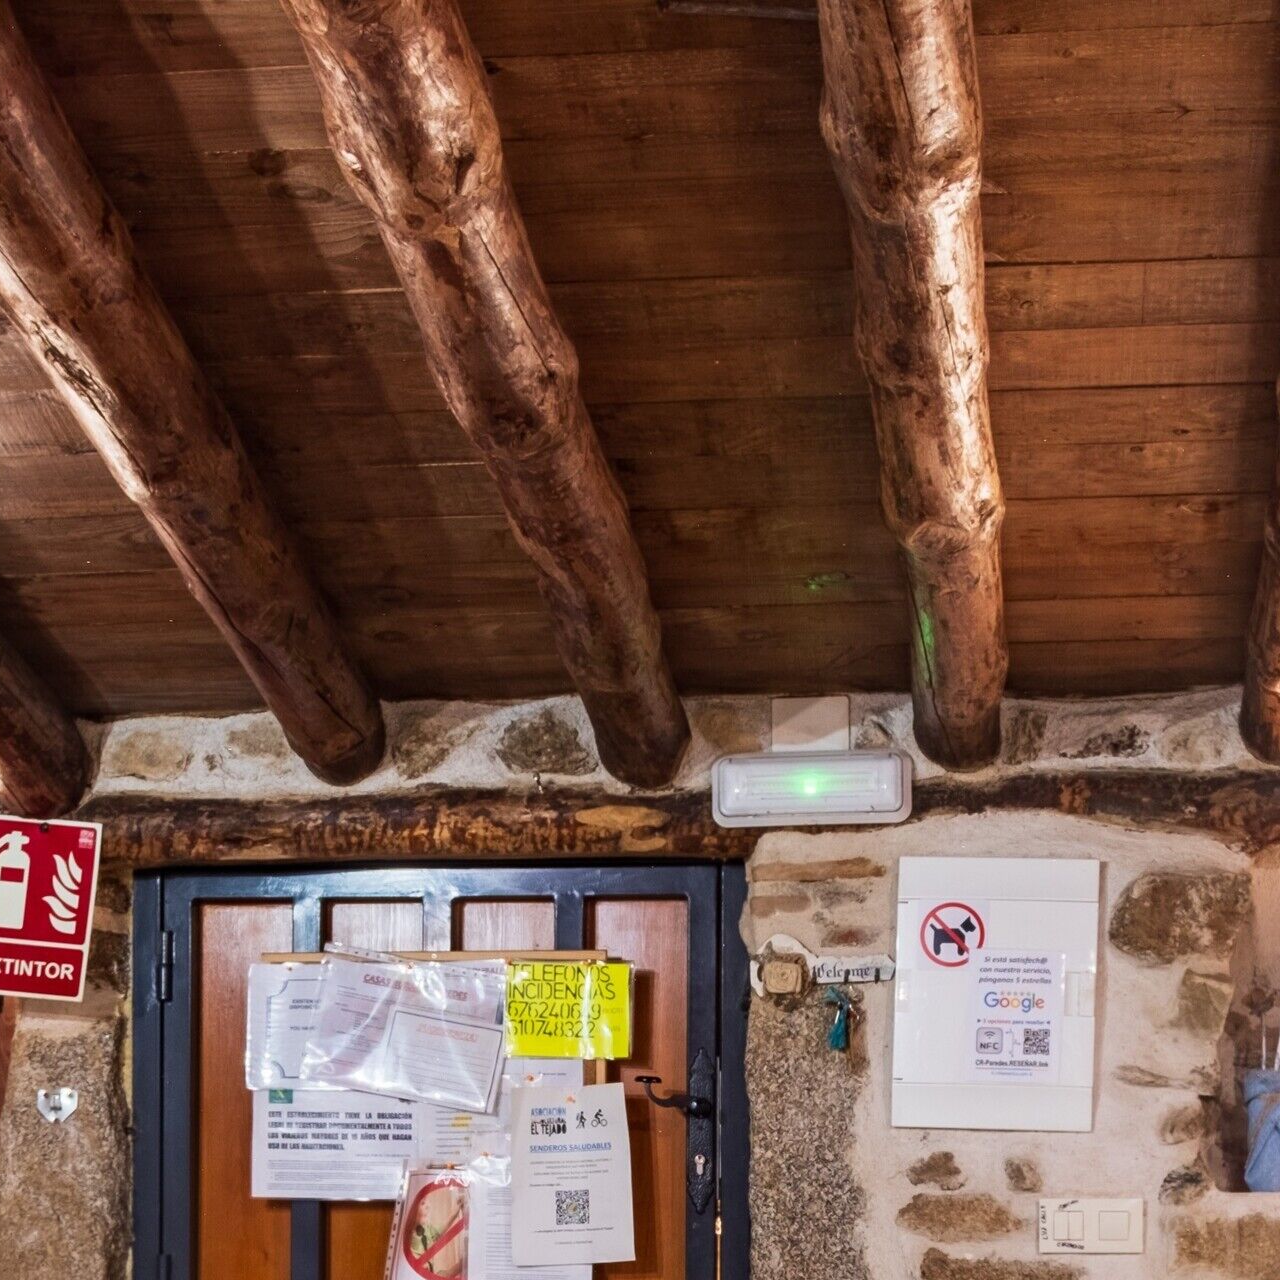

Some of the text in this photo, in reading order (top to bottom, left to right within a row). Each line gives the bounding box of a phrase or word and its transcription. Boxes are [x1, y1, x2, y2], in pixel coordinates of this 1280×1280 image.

[983, 991, 1045, 1013] Google
[980, 1042, 1000, 1050] NFC
[531, 1123, 567, 1137] EL TEJADO
[530, 1142, 612, 1153] SENDEROS SALUDABLES
